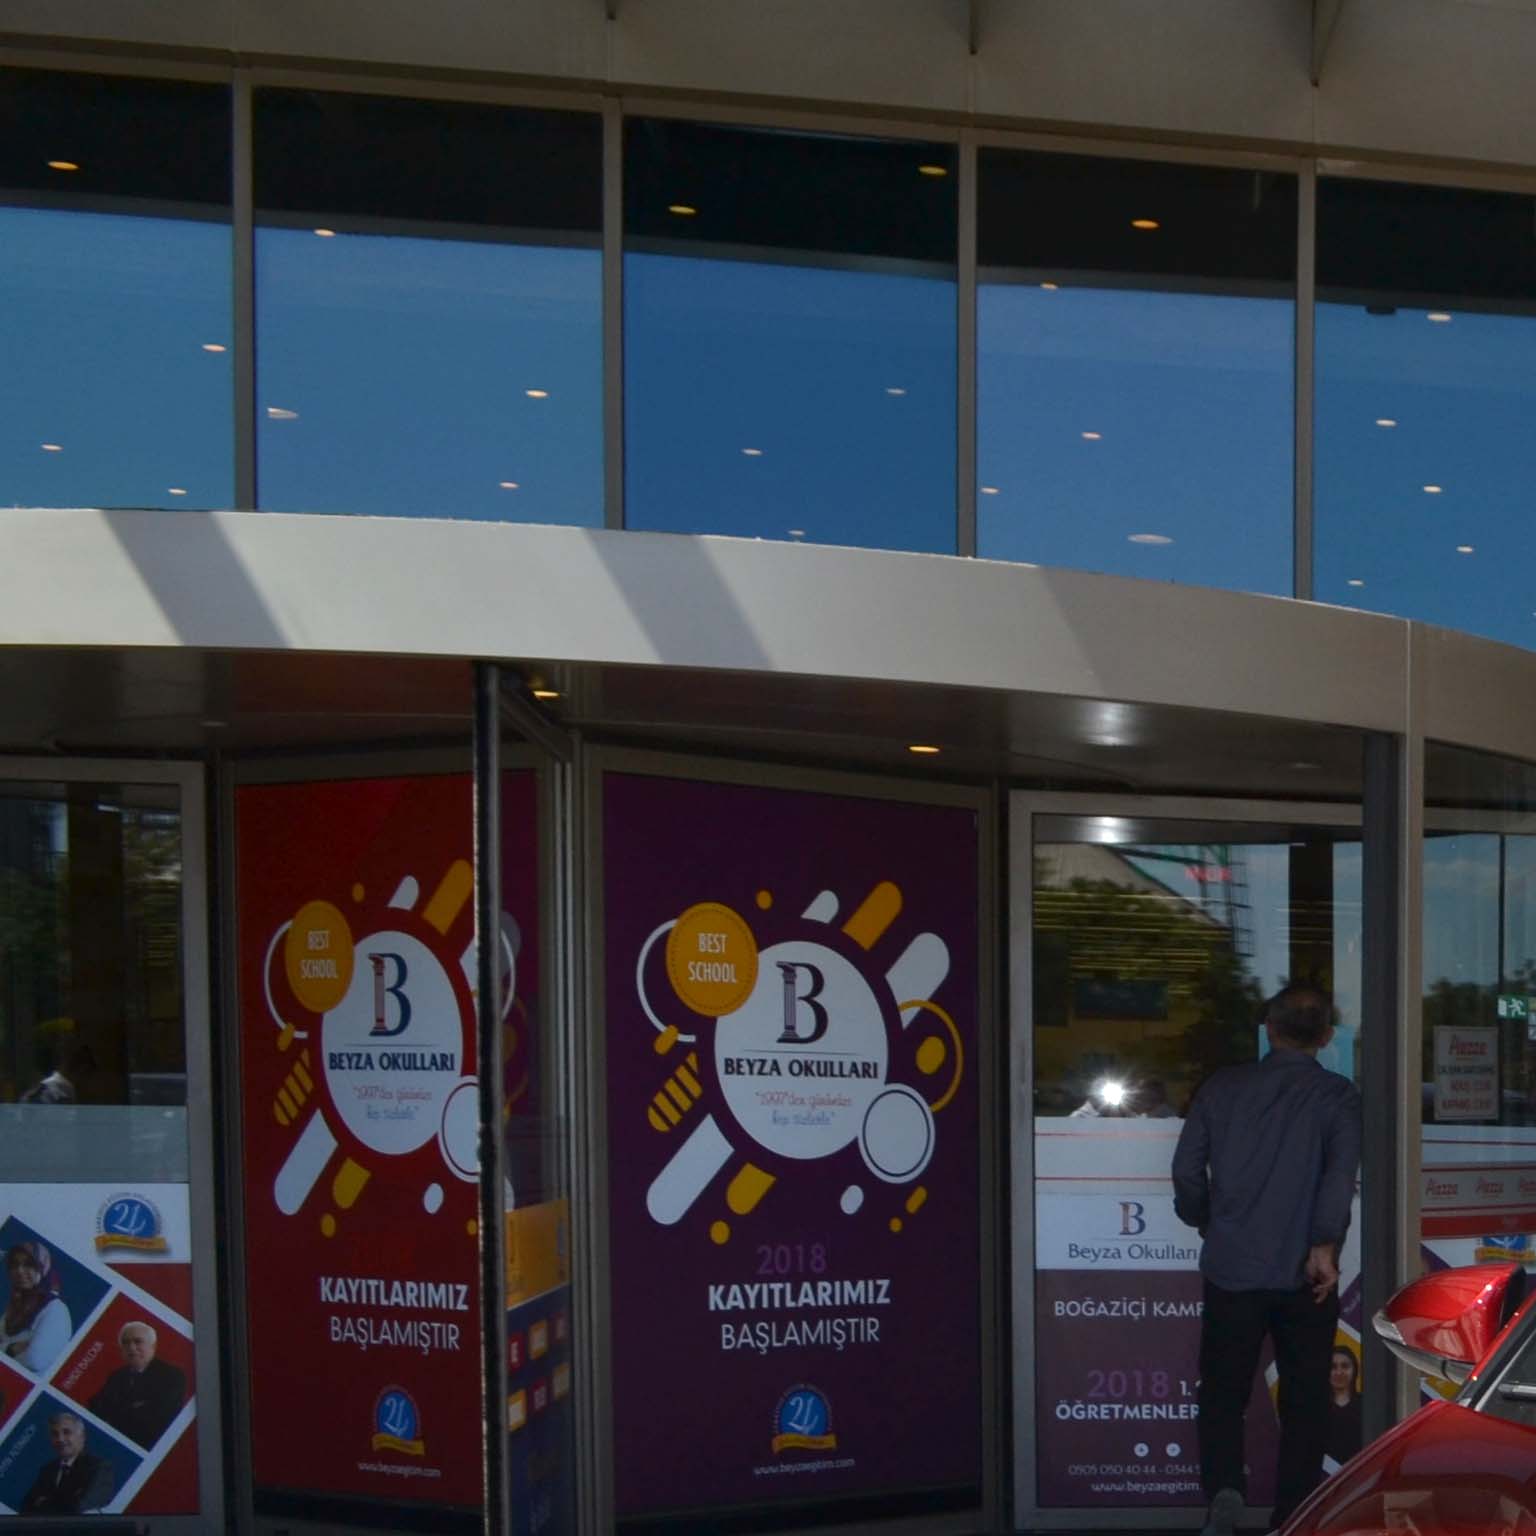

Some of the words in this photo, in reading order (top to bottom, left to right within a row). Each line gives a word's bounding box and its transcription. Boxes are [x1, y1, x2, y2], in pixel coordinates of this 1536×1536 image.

[307, 930, 330, 949] BEST
[698, 932, 728, 954] BEST
[301, 959, 339, 979] SCHOOL
[688, 961, 737, 984] SCHOOL
[328, 1052, 375, 1071] BEYZA
[379, 1052, 456, 1072] OKULLARI
[723, 1057, 782, 1077] BEYZA
[788, 1058, 879, 1080] OKULLARI
[757, 1242, 829, 1276] 2018
[1068, 1243, 1122, 1263] Beyza
[319, 1276, 470, 1312] KAYITLARIMIZ
[708, 1278, 892, 1312] KAYITLARIMIZ
[1055, 1297, 1146, 1320] BOĞAZİÇİ
[328, 1315, 461, 1356] BAŞLAMIŞTIR
[720, 1316, 881, 1356] BAŞLAMIŞTIR
[1087, 1369, 1170, 1398] 2018
